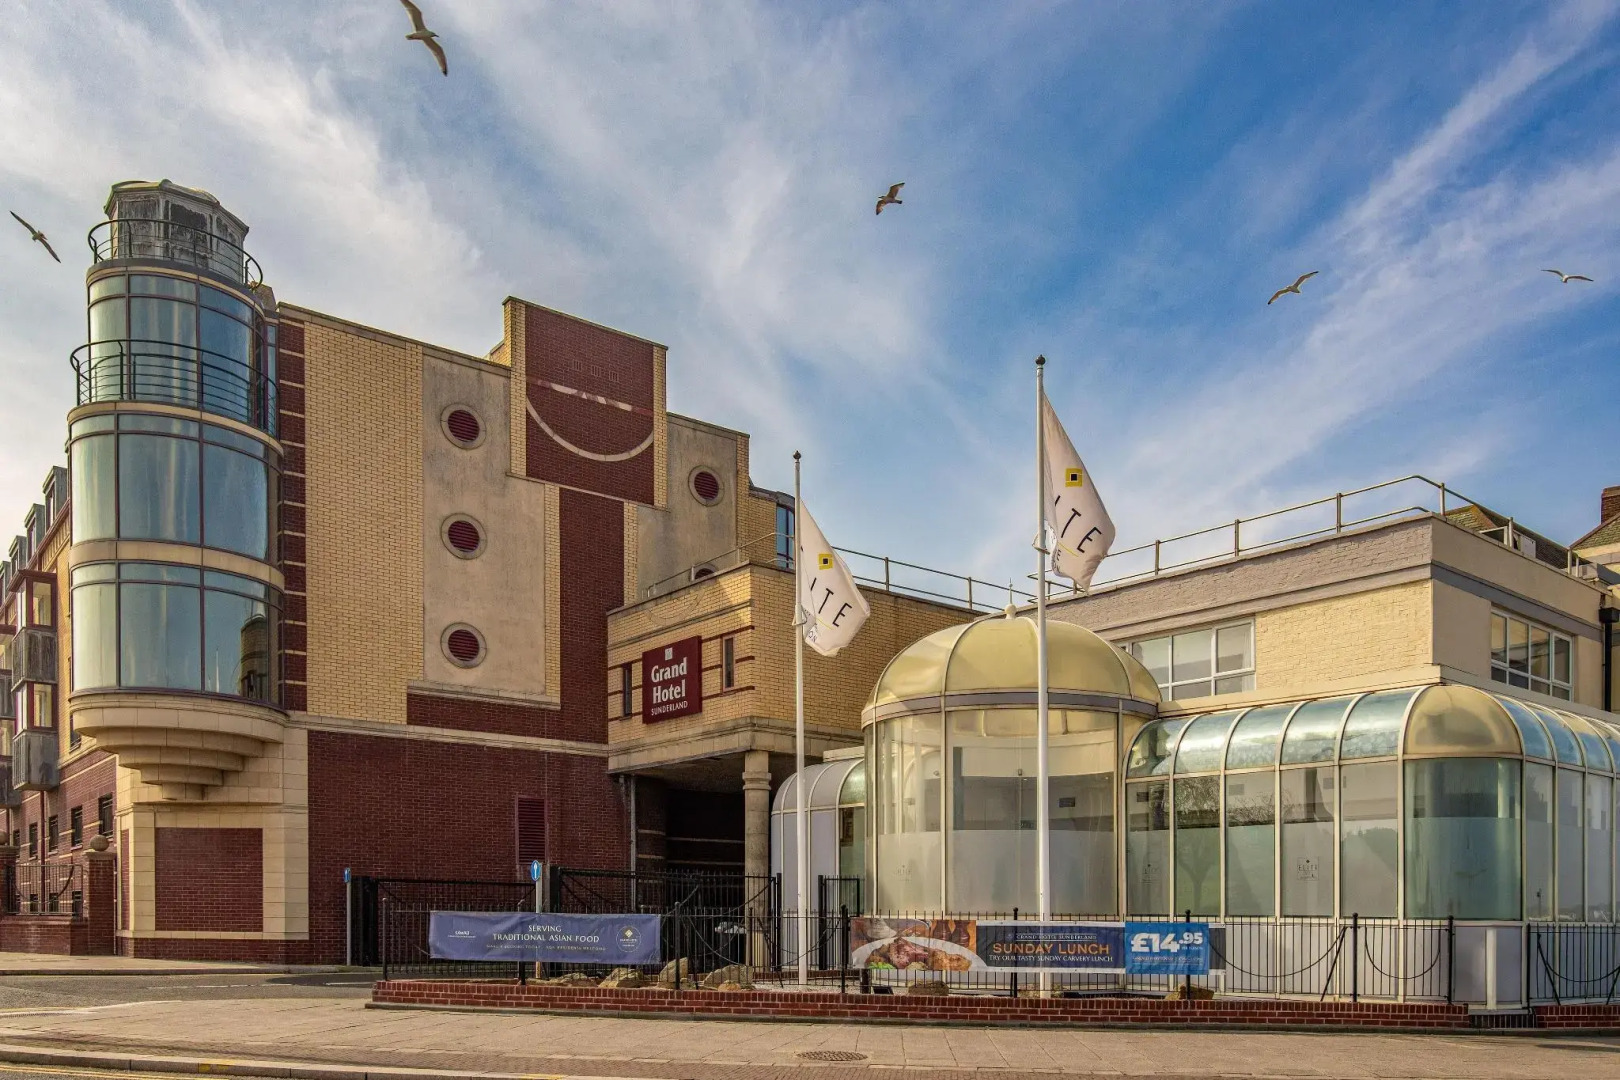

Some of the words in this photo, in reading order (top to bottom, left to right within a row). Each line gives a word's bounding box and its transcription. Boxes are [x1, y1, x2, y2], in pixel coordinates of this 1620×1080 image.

[651, 657, 687, 683] Grand
[652, 679, 686, 704] Hotel
[651, 700, 689, 716] SUNDERLAND
[528, 924, 562, 932] SERVING
[492, 933, 546, 941] TRADITIONAL
[548, 934, 573, 942] ASIAN
[575, 935, 600, 943] FOOD
[1130, 931, 1204, 953] £14.95
[993, 942, 1054, 954] SUNDAY
[1058, 943, 1110, 955] LUNCH
